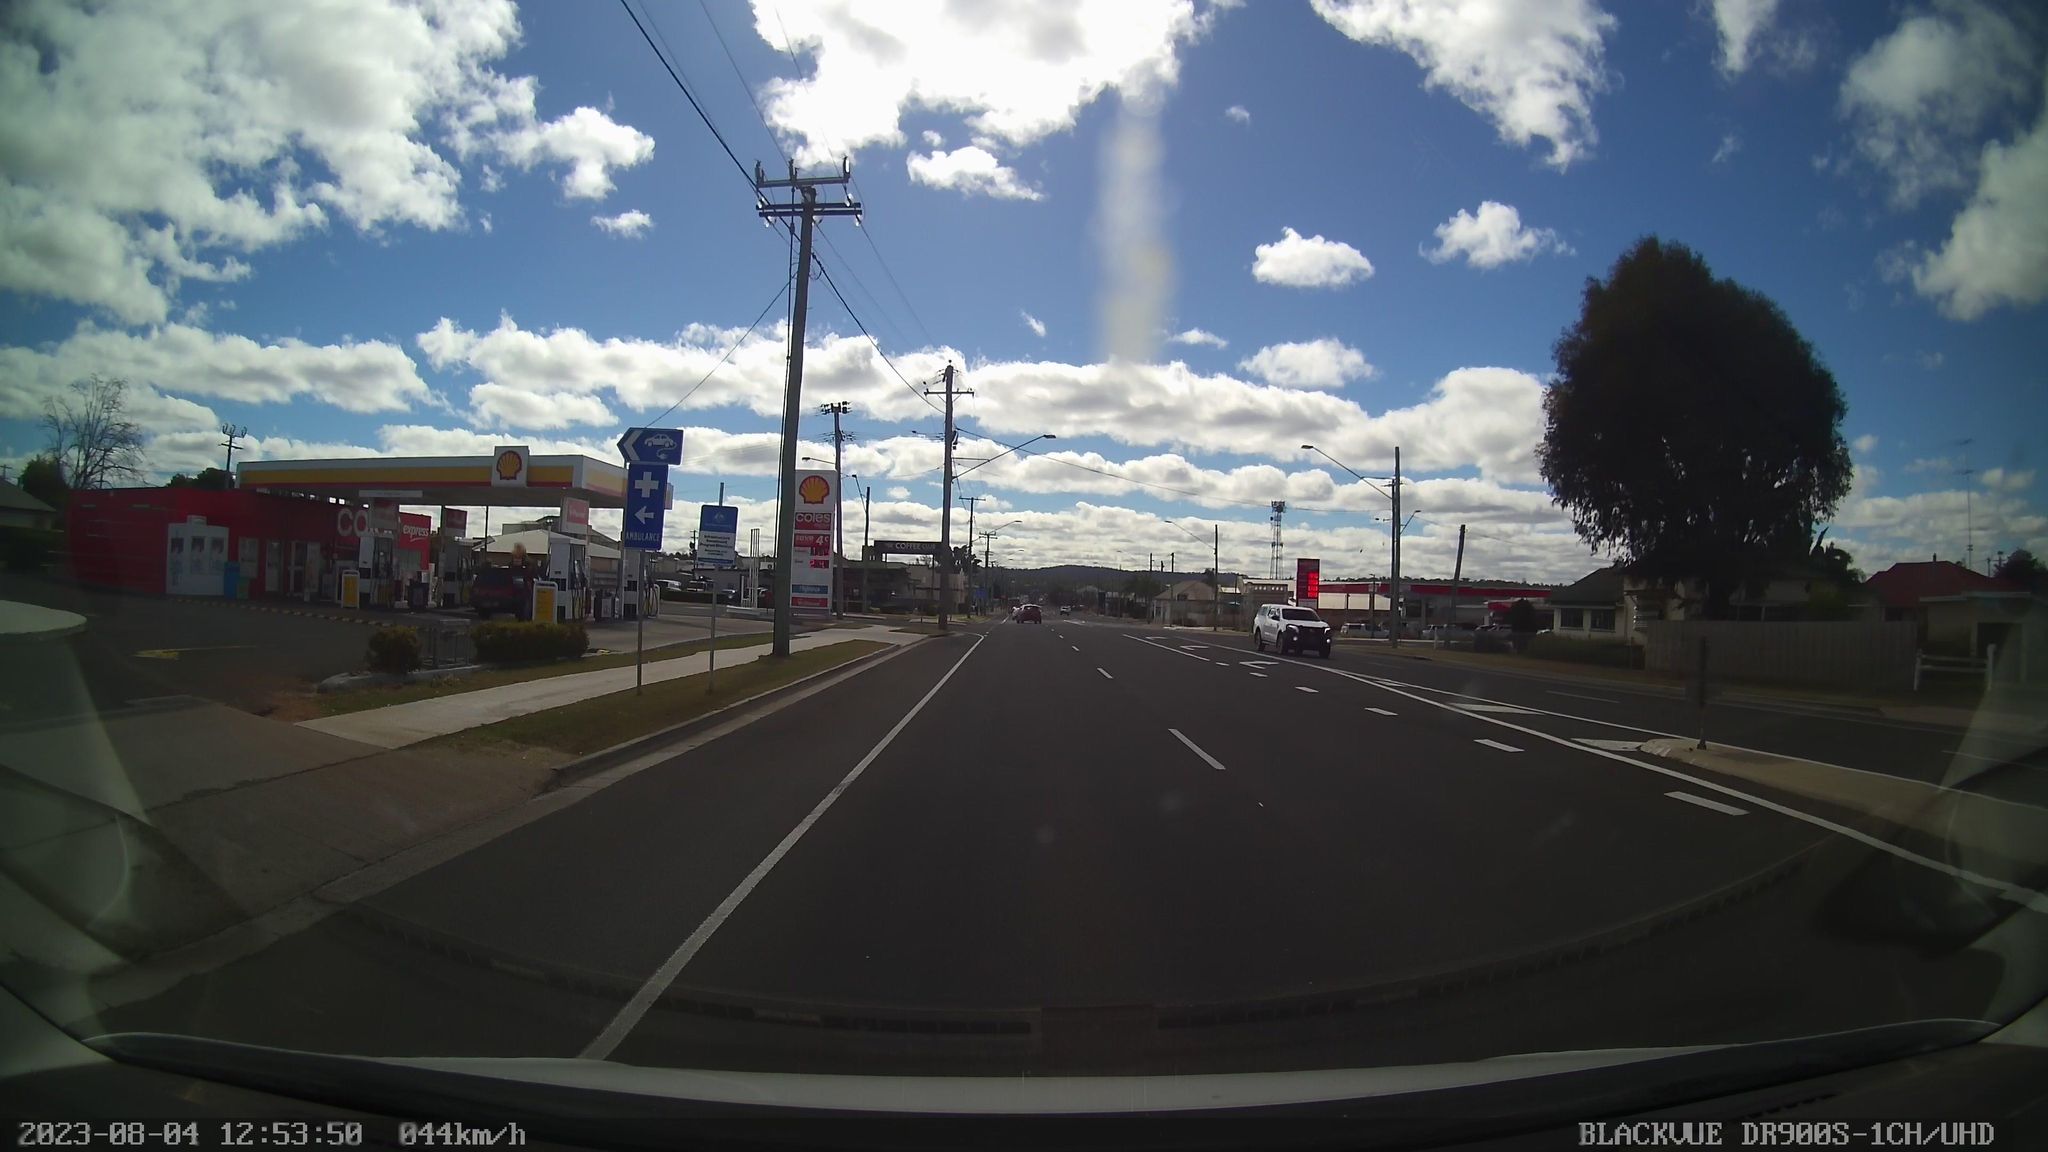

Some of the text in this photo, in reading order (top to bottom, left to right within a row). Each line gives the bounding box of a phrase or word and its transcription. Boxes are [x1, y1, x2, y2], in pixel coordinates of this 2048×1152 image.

[796, 512, 830, 523] coles
[403, 525, 429, 538] express
[625, 531, 660, 541] AMBULANCE
